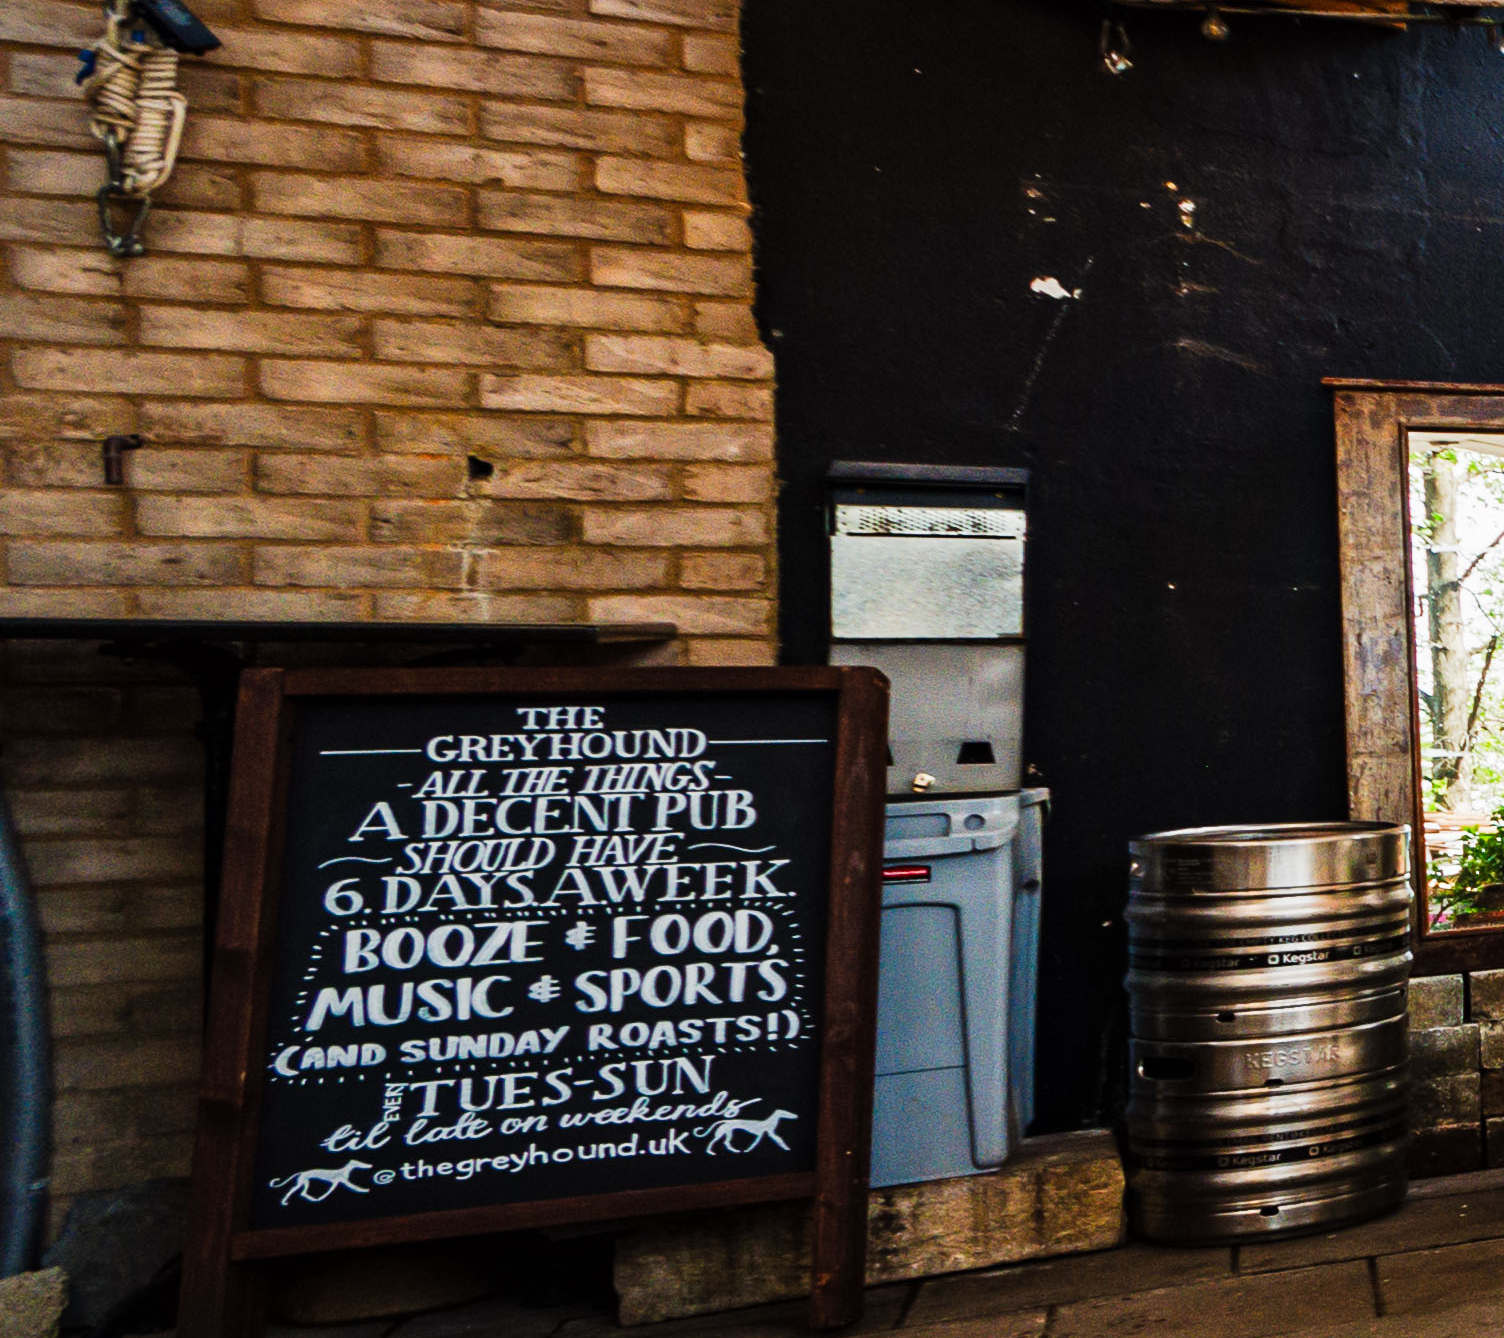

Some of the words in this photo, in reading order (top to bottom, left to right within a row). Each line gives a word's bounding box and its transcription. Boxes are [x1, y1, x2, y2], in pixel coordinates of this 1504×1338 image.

[517, 706, 606, 730] THE
[426, 728, 708, 762] GREYHOUND
[501, 766, 575, 797] THE
[348, 801, 409, 842] A
[421, 793, 646, 839] DECENT
[655, 790, 758, 831] PUB
[396, 836, 557, 876] SHOULD
[567, 832, 686, 867] HAVE
[343, 920, 551, 974] BOOZE
[565, 921, 597, 951] &
[611, 909, 781, 960] FOOD,
[1282, 951, 1330, 965] Kegstar
[305, 975, 515, 1032] MUSIC
[527, 974, 562, 1004] &
[573, 959, 790, 1013] SPORTS
[272, 1043, 387, 1077] (AND
[400, 1025, 571, 1064] SUNDAY
[588, 1009, 801, 1051] ROASTS!)
[1246, 1044, 1341, 1070] KEGSTAR
[409, 1055, 717, 1118] TUES-SUN
[319, 1122, 392, 1152] til
[403, 1111, 494, 1146] late
[499, 1114, 550, 1136] on
[558, 1090, 763, 1130] weekends
